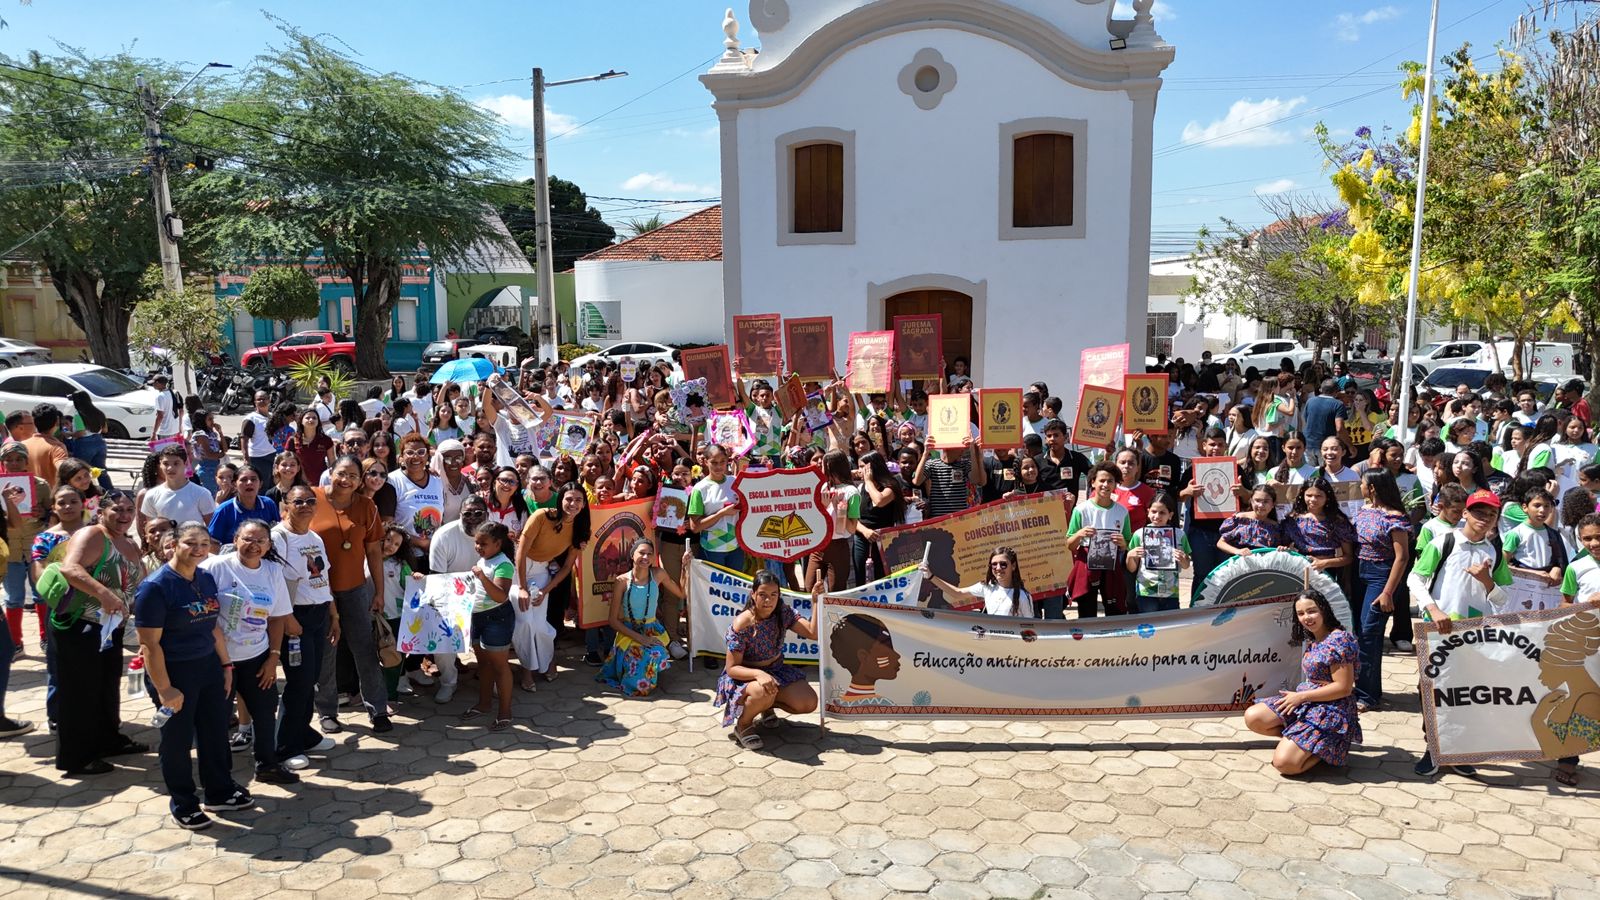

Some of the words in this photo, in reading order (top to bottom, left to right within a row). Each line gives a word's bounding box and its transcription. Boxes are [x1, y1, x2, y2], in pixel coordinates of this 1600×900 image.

[739, 320, 774, 328] BATUQUE
[855, 336, 888, 345] UMBANDA
[686, 352, 722, 361] QUIMBANDA
[749, 490, 769, 499] ESCOLA
[784, 487, 811, 497] VEREADOR
[751, 504, 773, 513] MANOEL
[774, 502, 797, 511] PEREIRA
[798, 501, 812, 510] NETO
[965, 520, 1020, 542] CONSCIÊNCIA
[1022, 515, 1050, 530] NEGRA
[1424, 625, 1542, 679] CONSCIÊNCIA
[913, 651, 982, 674] Educação
[986, 654, 1081, 668] antirracista:
[1084, 652, 1148, 668] caminho
[1152, 655, 1187, 671] para
[1190, 654, 1200, 665] a
[1204, 648, 1282, 671] igualdade.
[1434, 685, 1537, 707] NEGRA
